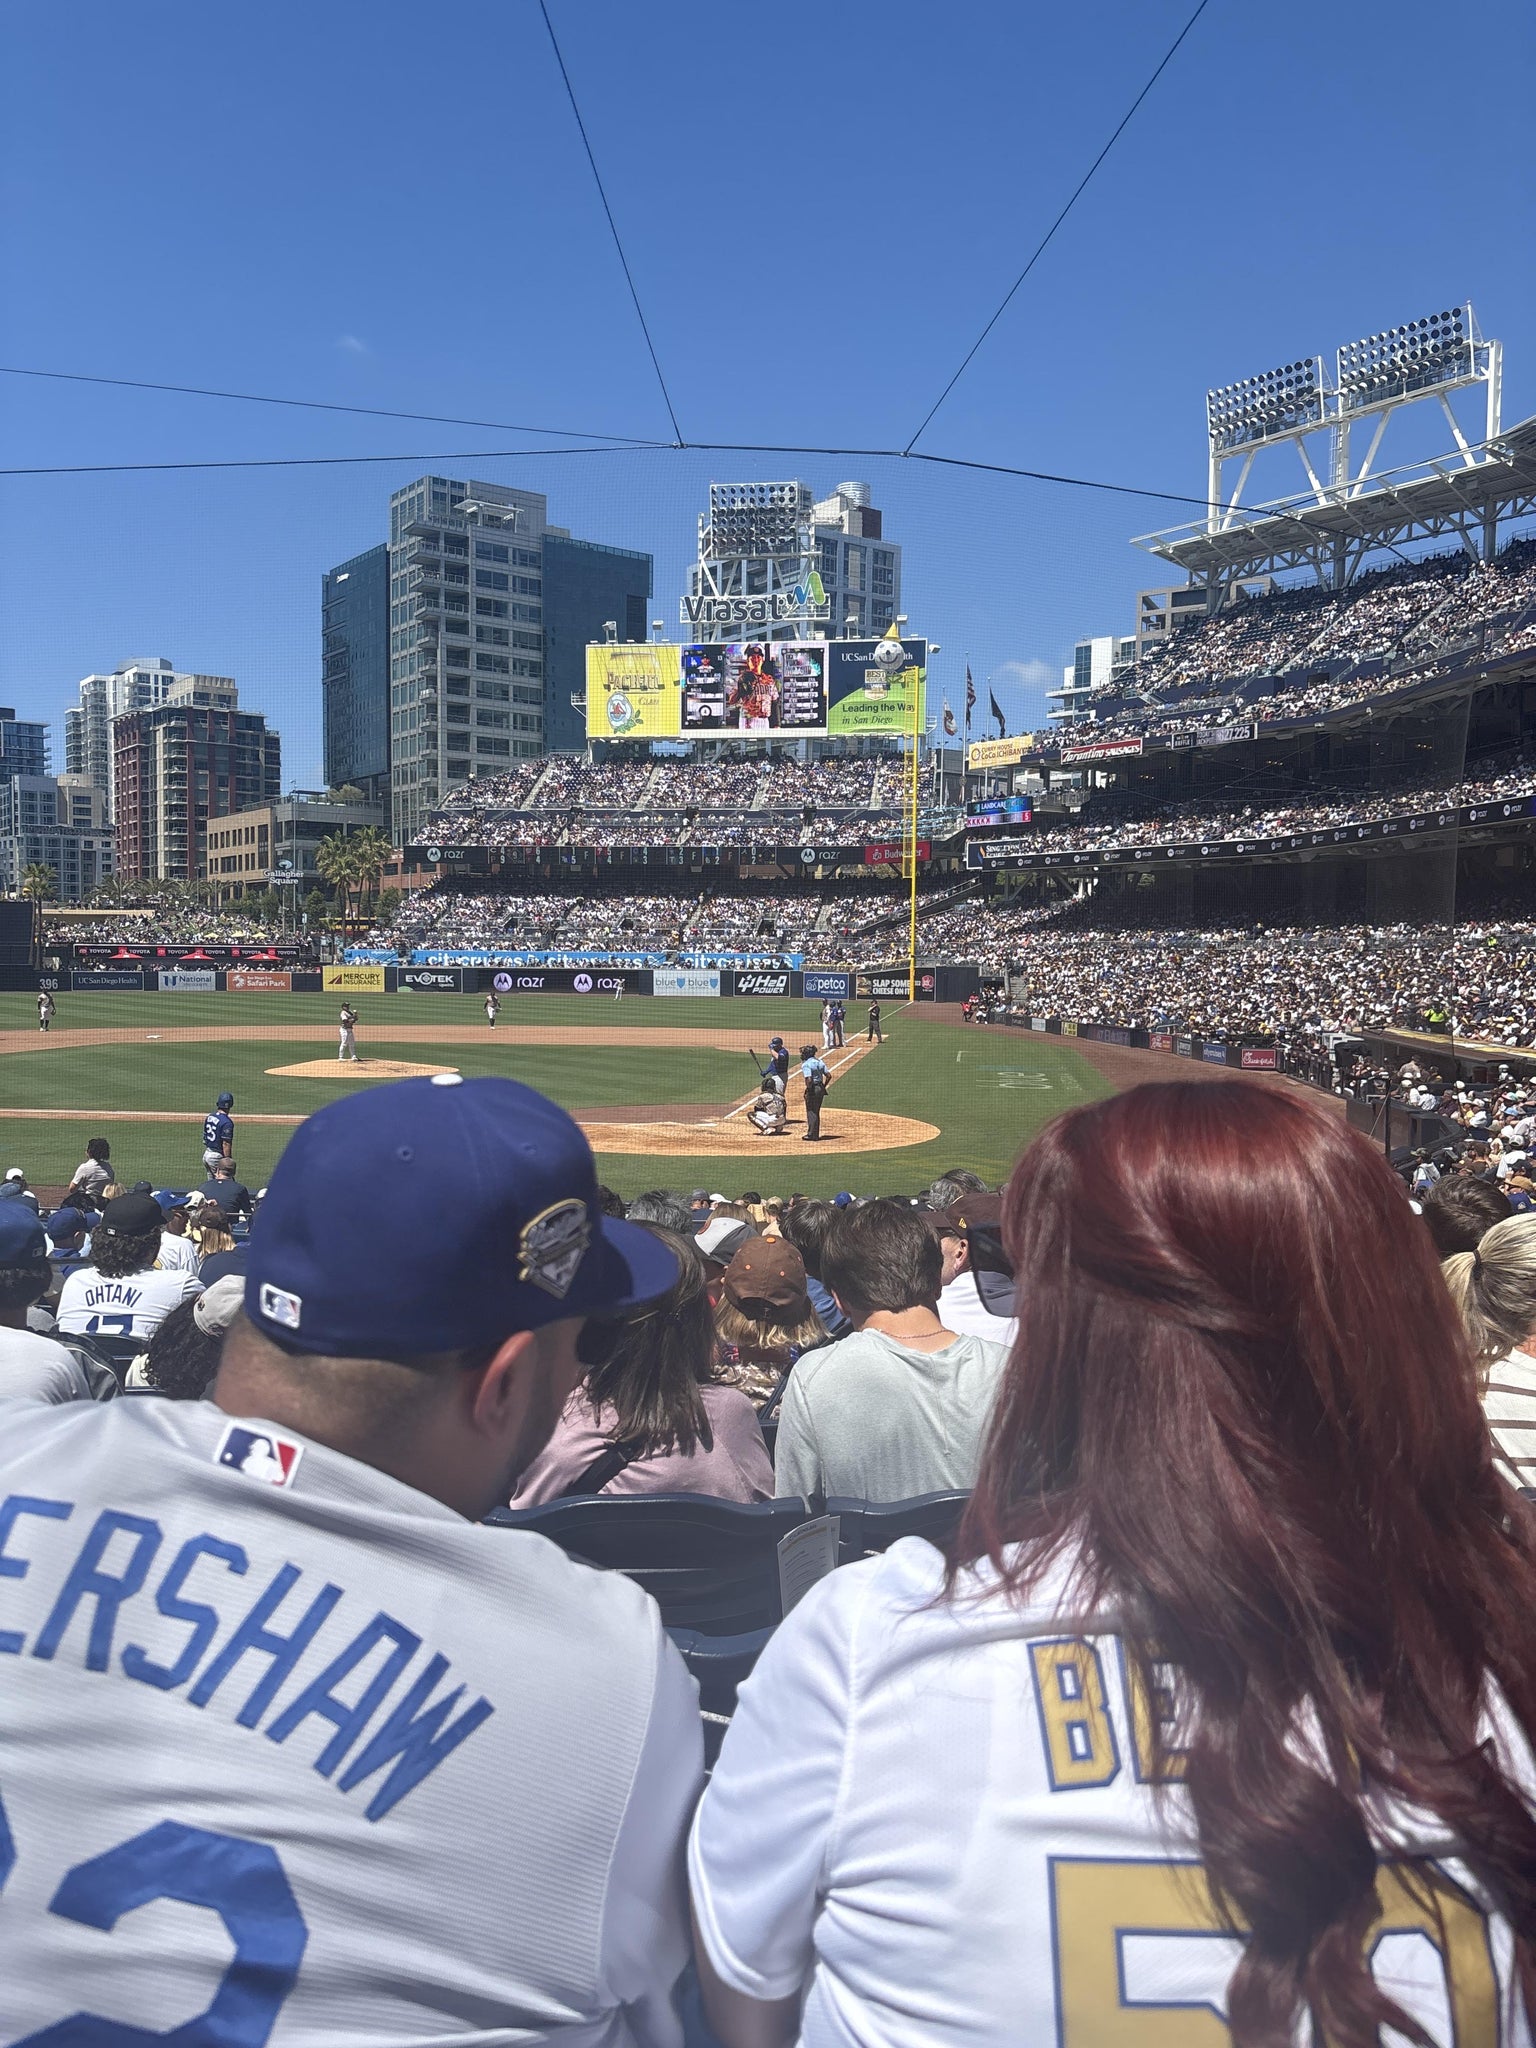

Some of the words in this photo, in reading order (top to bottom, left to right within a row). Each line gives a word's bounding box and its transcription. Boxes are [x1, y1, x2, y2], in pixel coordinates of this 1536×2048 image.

[684, 597, 784, 622] Viasat
[841, 652, 854, 661] UC
[854, 652, 868, 662] San
[842, 704, 878, 713] Leading
[881, 703, 895, 712] the
[897, 703, 915, 712] Way
[842, 716, 850, 724] in
[853, 716, 868, 724] San
[871, 716, 893, 724] Diego
[1062, 746, 1105, 763] Tarantino
[1105, 745, 1141, 758] SAUSAGES
[444, 850, 465, 859] razr
[818, 851, 840, 859] razr
[264, 870, 304, 878] Gallagher
[269, 877, 298, 886] Square
[100, 978, 118, 986] Diego
[406, 972, 454, 985] EVOTEK
[517, 978, 544, 988] razr
[656, 978, 676, 986] blue
[688, 978, 709, 987] blue
[756, 976, 788, 988] H2O
[872, 979, 890, 987] SLAP
[891, 979, 910, 987] SOME
[40, 978, 58, 990] 396
[818, 977, 846, 992] petco
[85, 1284, 143, 1308] OHTANI
